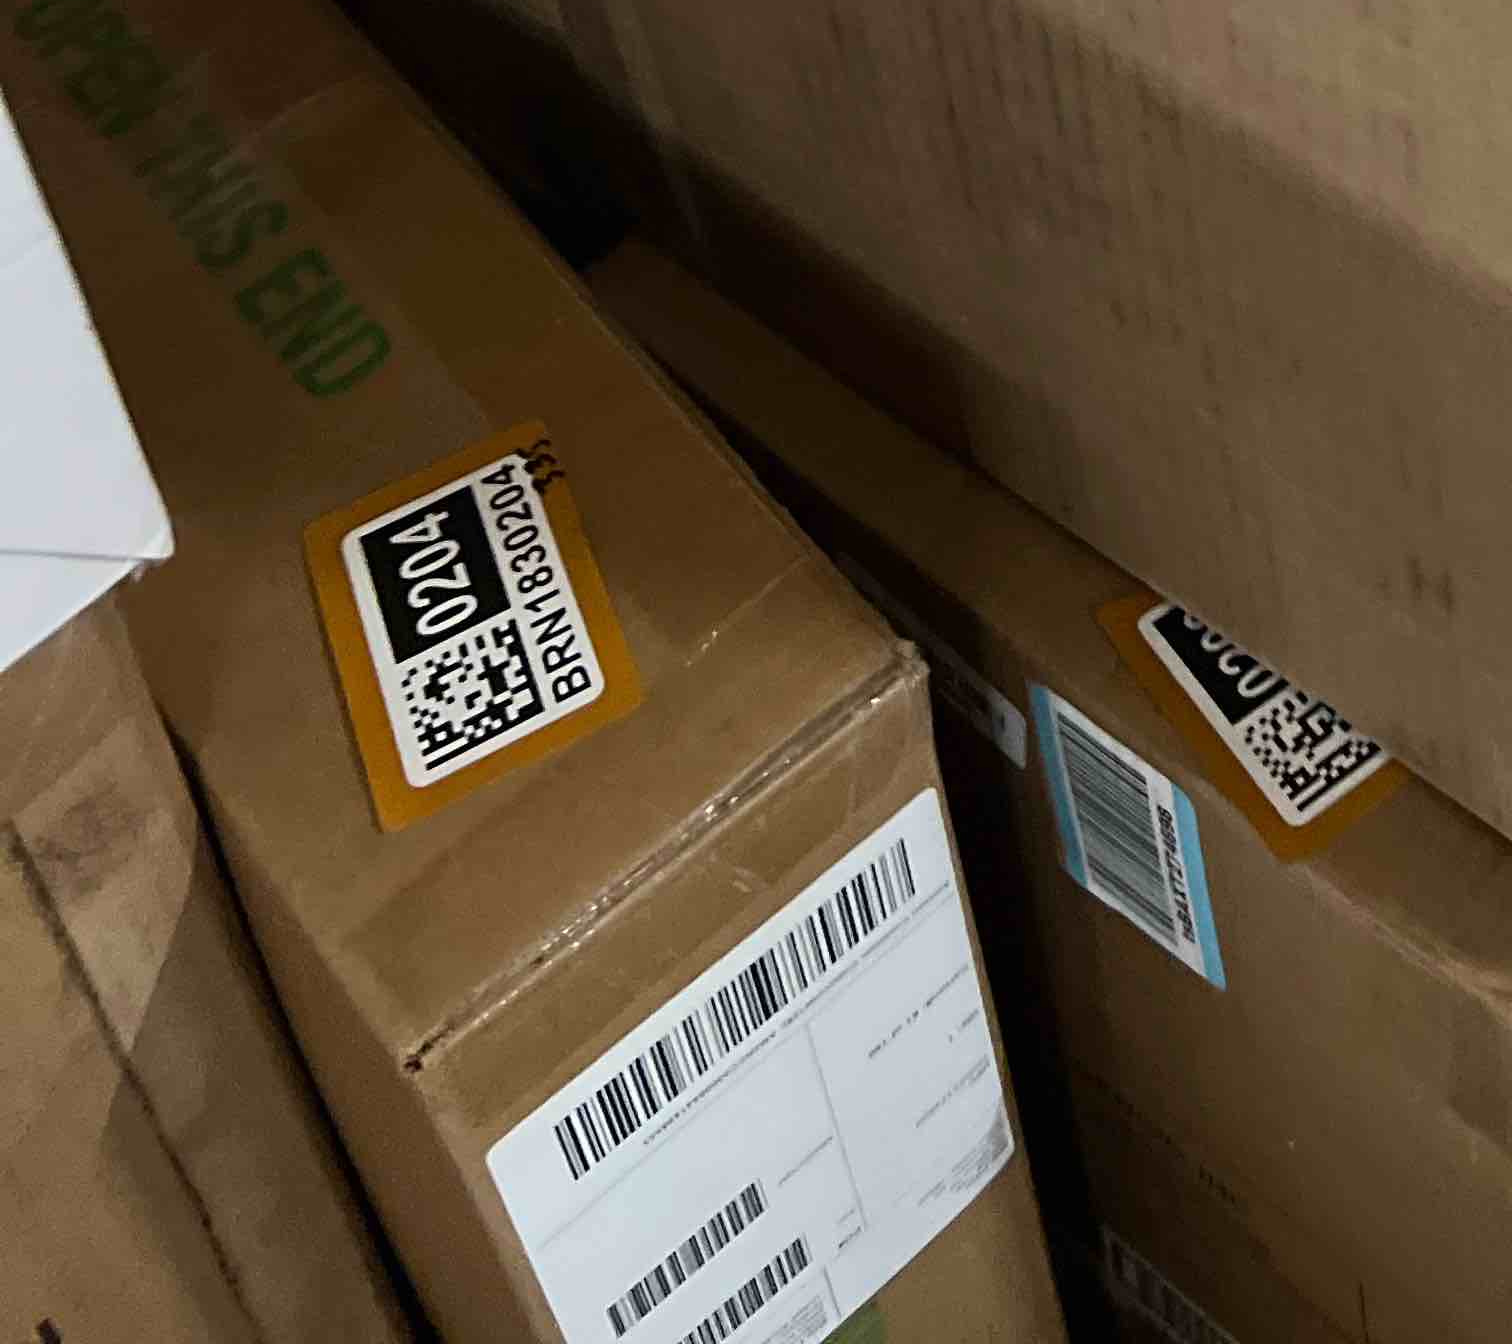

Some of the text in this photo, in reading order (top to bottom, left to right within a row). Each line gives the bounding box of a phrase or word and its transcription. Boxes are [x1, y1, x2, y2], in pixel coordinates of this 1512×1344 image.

[134, 92, 290, 274] THIS
[234, 248, 391, 399] END
[400, 509, 478, 639] 0204
[480, 462, 589, 704] BRN1830204
[1183, 608, 1276, 700] 02
